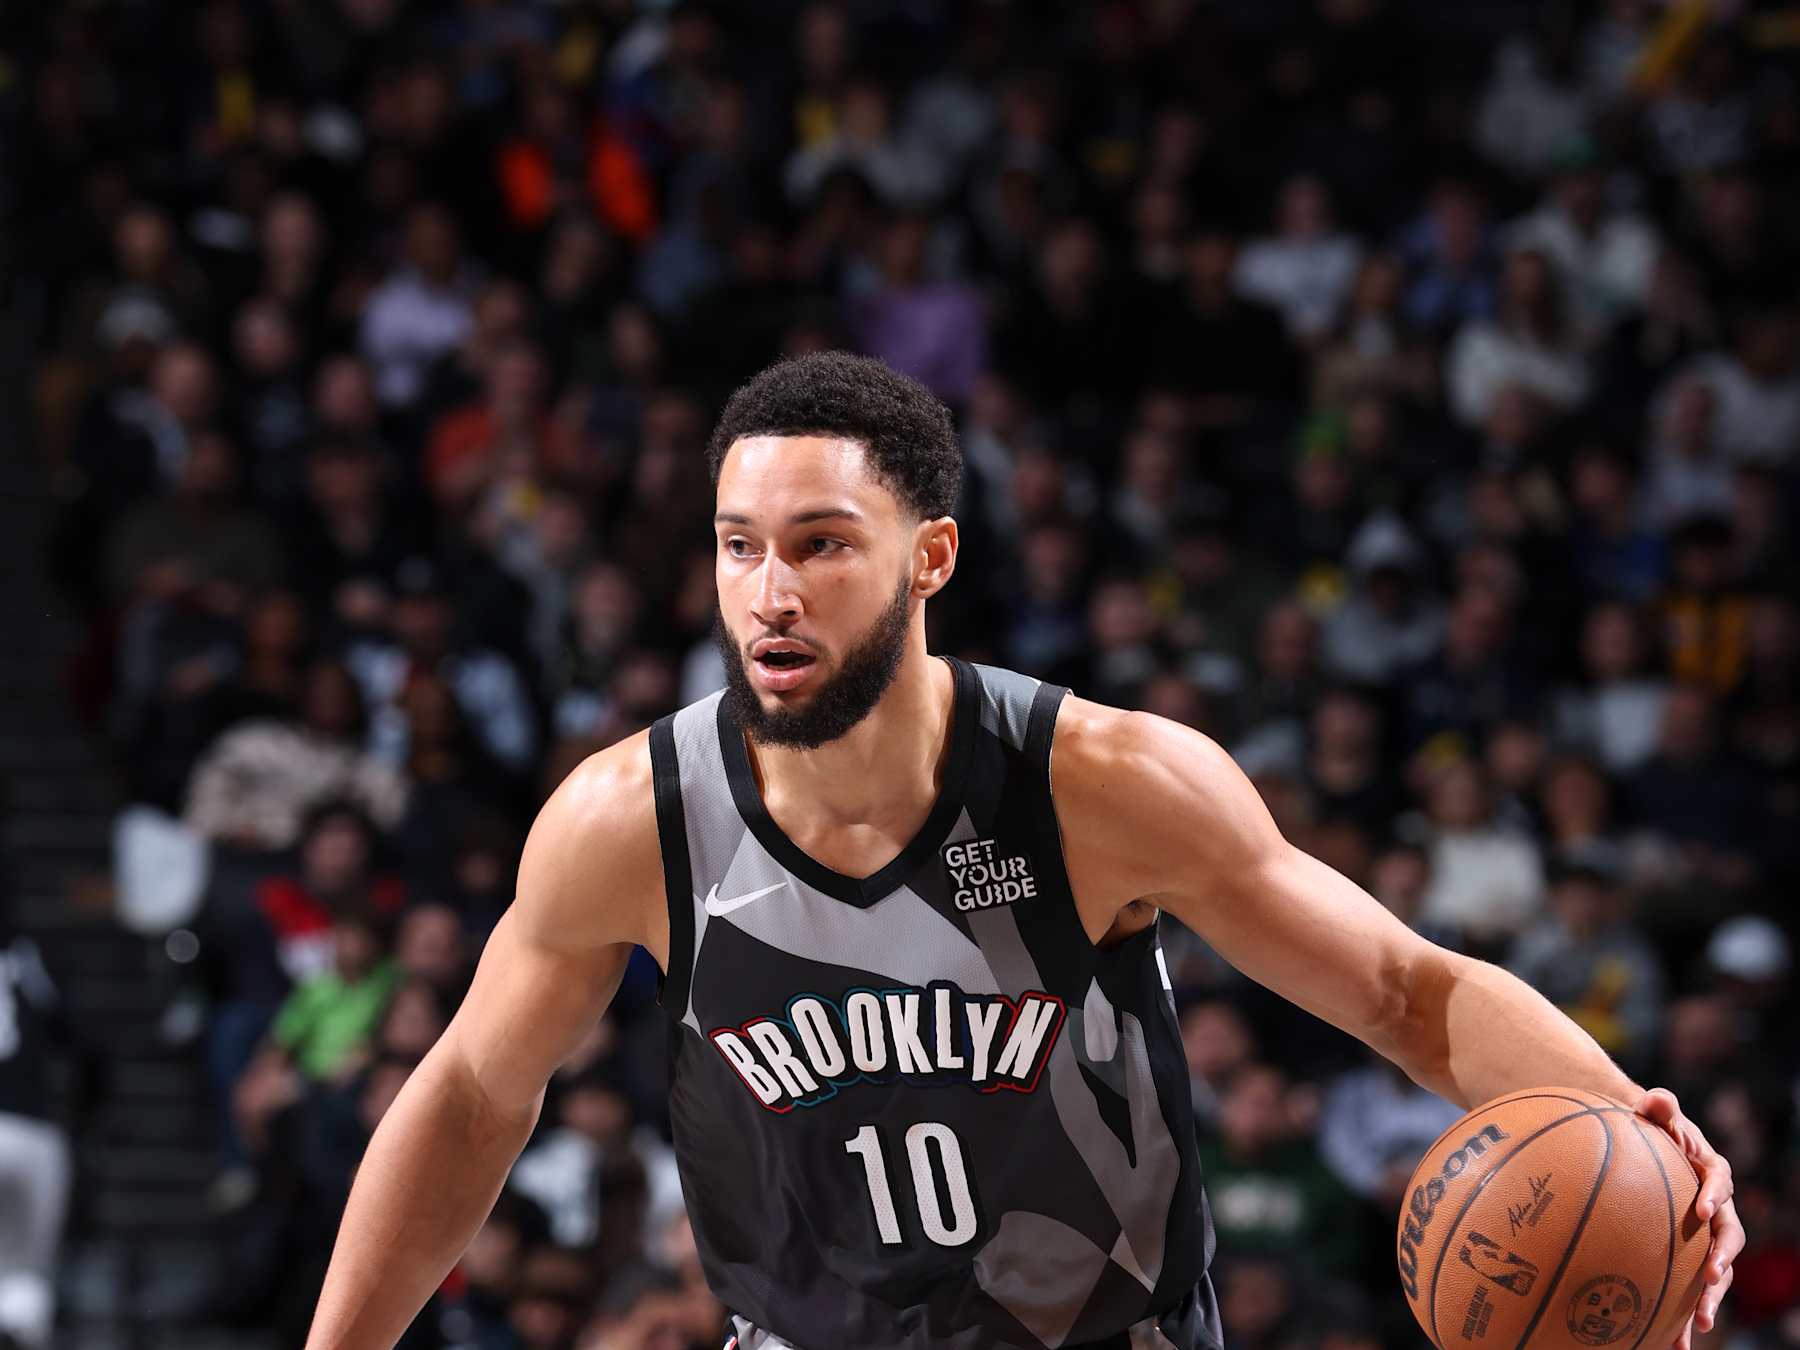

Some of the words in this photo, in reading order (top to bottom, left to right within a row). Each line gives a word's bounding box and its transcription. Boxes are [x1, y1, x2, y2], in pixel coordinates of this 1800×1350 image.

[946, 839, 995, 867] GET
[949, 857, 1028, 889] YOUR
[955, 877, 1037, 911] GUIDE
[712, 986, 1058, 1106] BROOKLYN
[845, 1122, 977, 1247] 10
